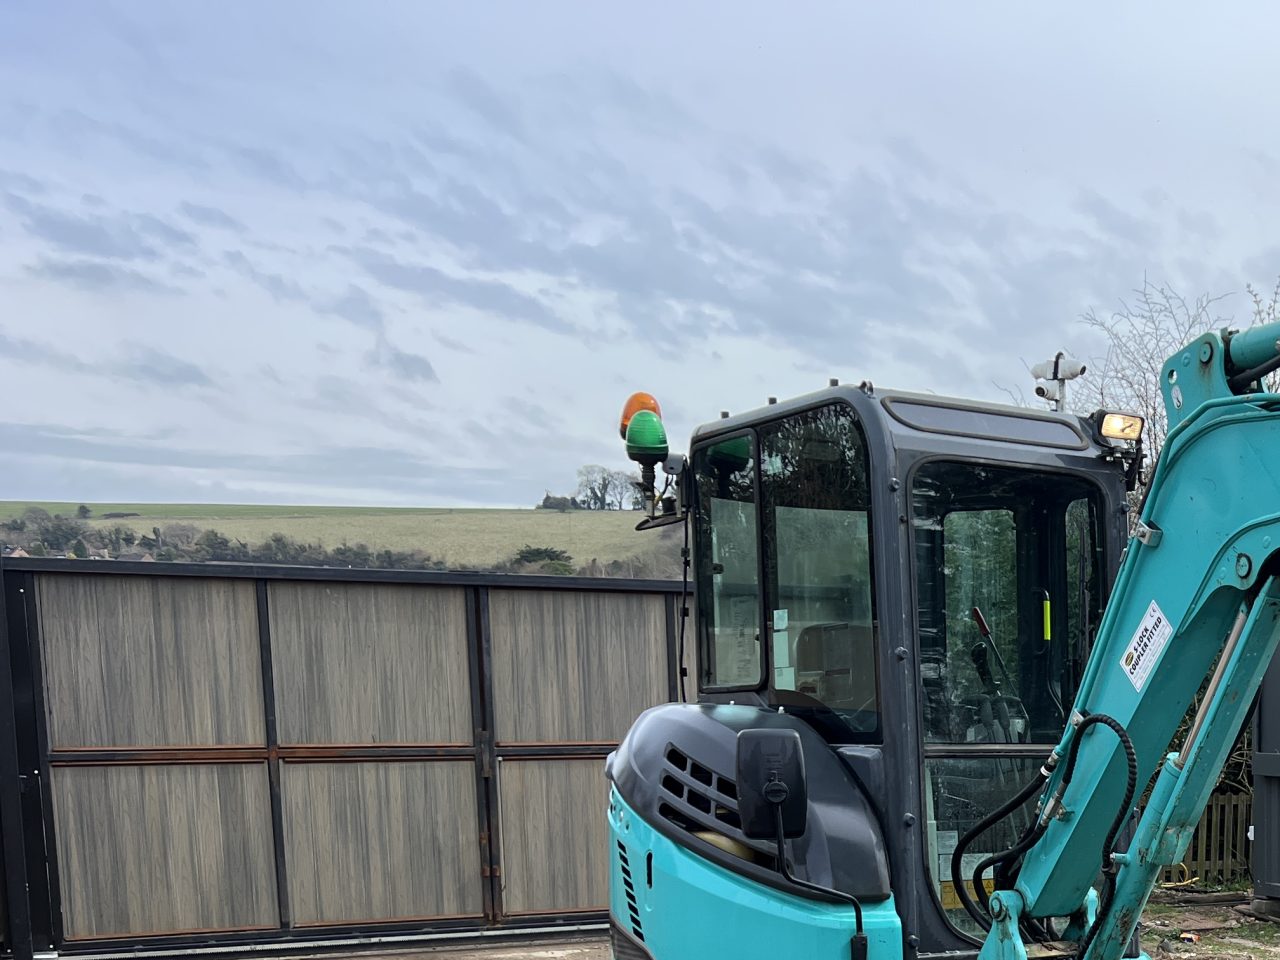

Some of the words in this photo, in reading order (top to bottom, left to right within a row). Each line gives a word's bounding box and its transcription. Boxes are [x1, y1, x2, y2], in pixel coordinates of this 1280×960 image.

[1129, 641, 1149, 675] COUPLER
[1146, 616, 1162, 643] FITTED
[1133, 626, 1149, 654] S-LOCK
